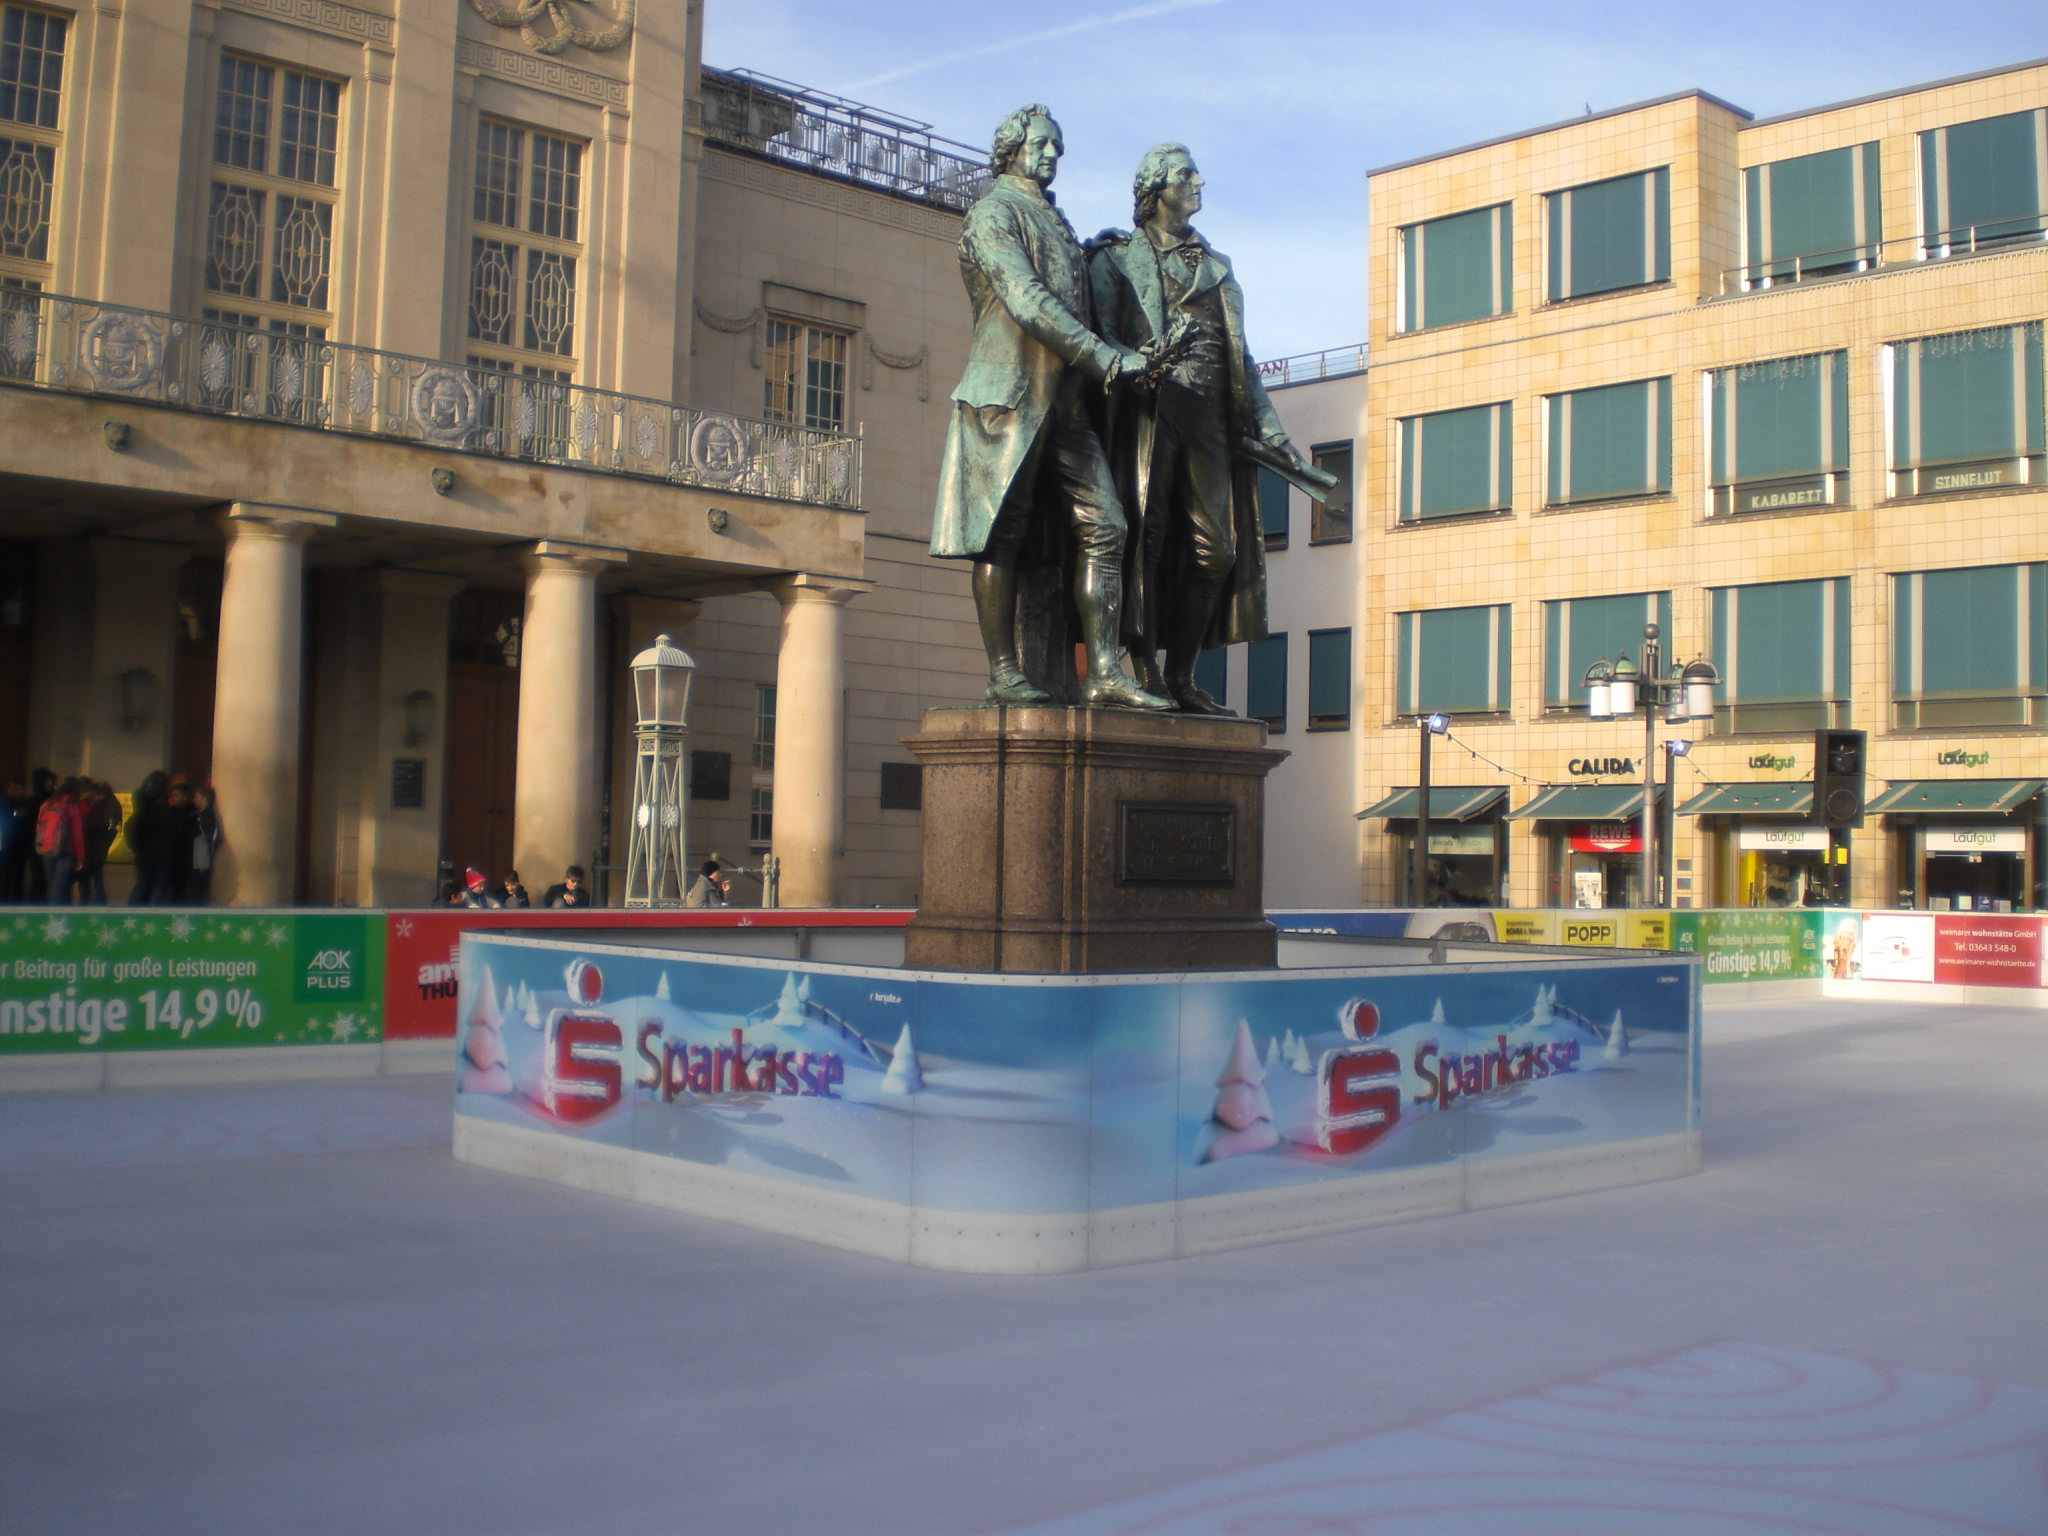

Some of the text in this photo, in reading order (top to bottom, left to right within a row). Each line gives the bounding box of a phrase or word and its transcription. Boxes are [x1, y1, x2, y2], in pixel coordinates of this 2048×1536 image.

[1935, 470, 2002, 489] SINNFLUT
[1751, 489, 1822, 509] KABARETT
[1568, 757, 1636, 776] CALIDA
[1589, 825, 1632, 839] REWE
[1567, 925, 1611, 942] POPP
[1939, 928, 2037, 938] weimarer wohnstätte GmbH
[1955, 943, 1968, 951] Tel.
[1969, 943, 1993, 952] 03643
[308, 950, 351, 969] AOK
[1708, 949, 1792, 978] Günstige 14,9 %
[15, 958, 76, 984] Beitrag
[83, 957, 107, 979] für
[114, 957, 161, 983] große
[168, 957, 256, 979] Leistungen
[307, 976, 351, 989] PLUS
[139, 989, 217, 1040] 14,9
[225, 989, 261, 1029] %
[635, 1017, 844, 1103] Sparkasse
[1413, 1035, 1581, 1110] Sparkasse
